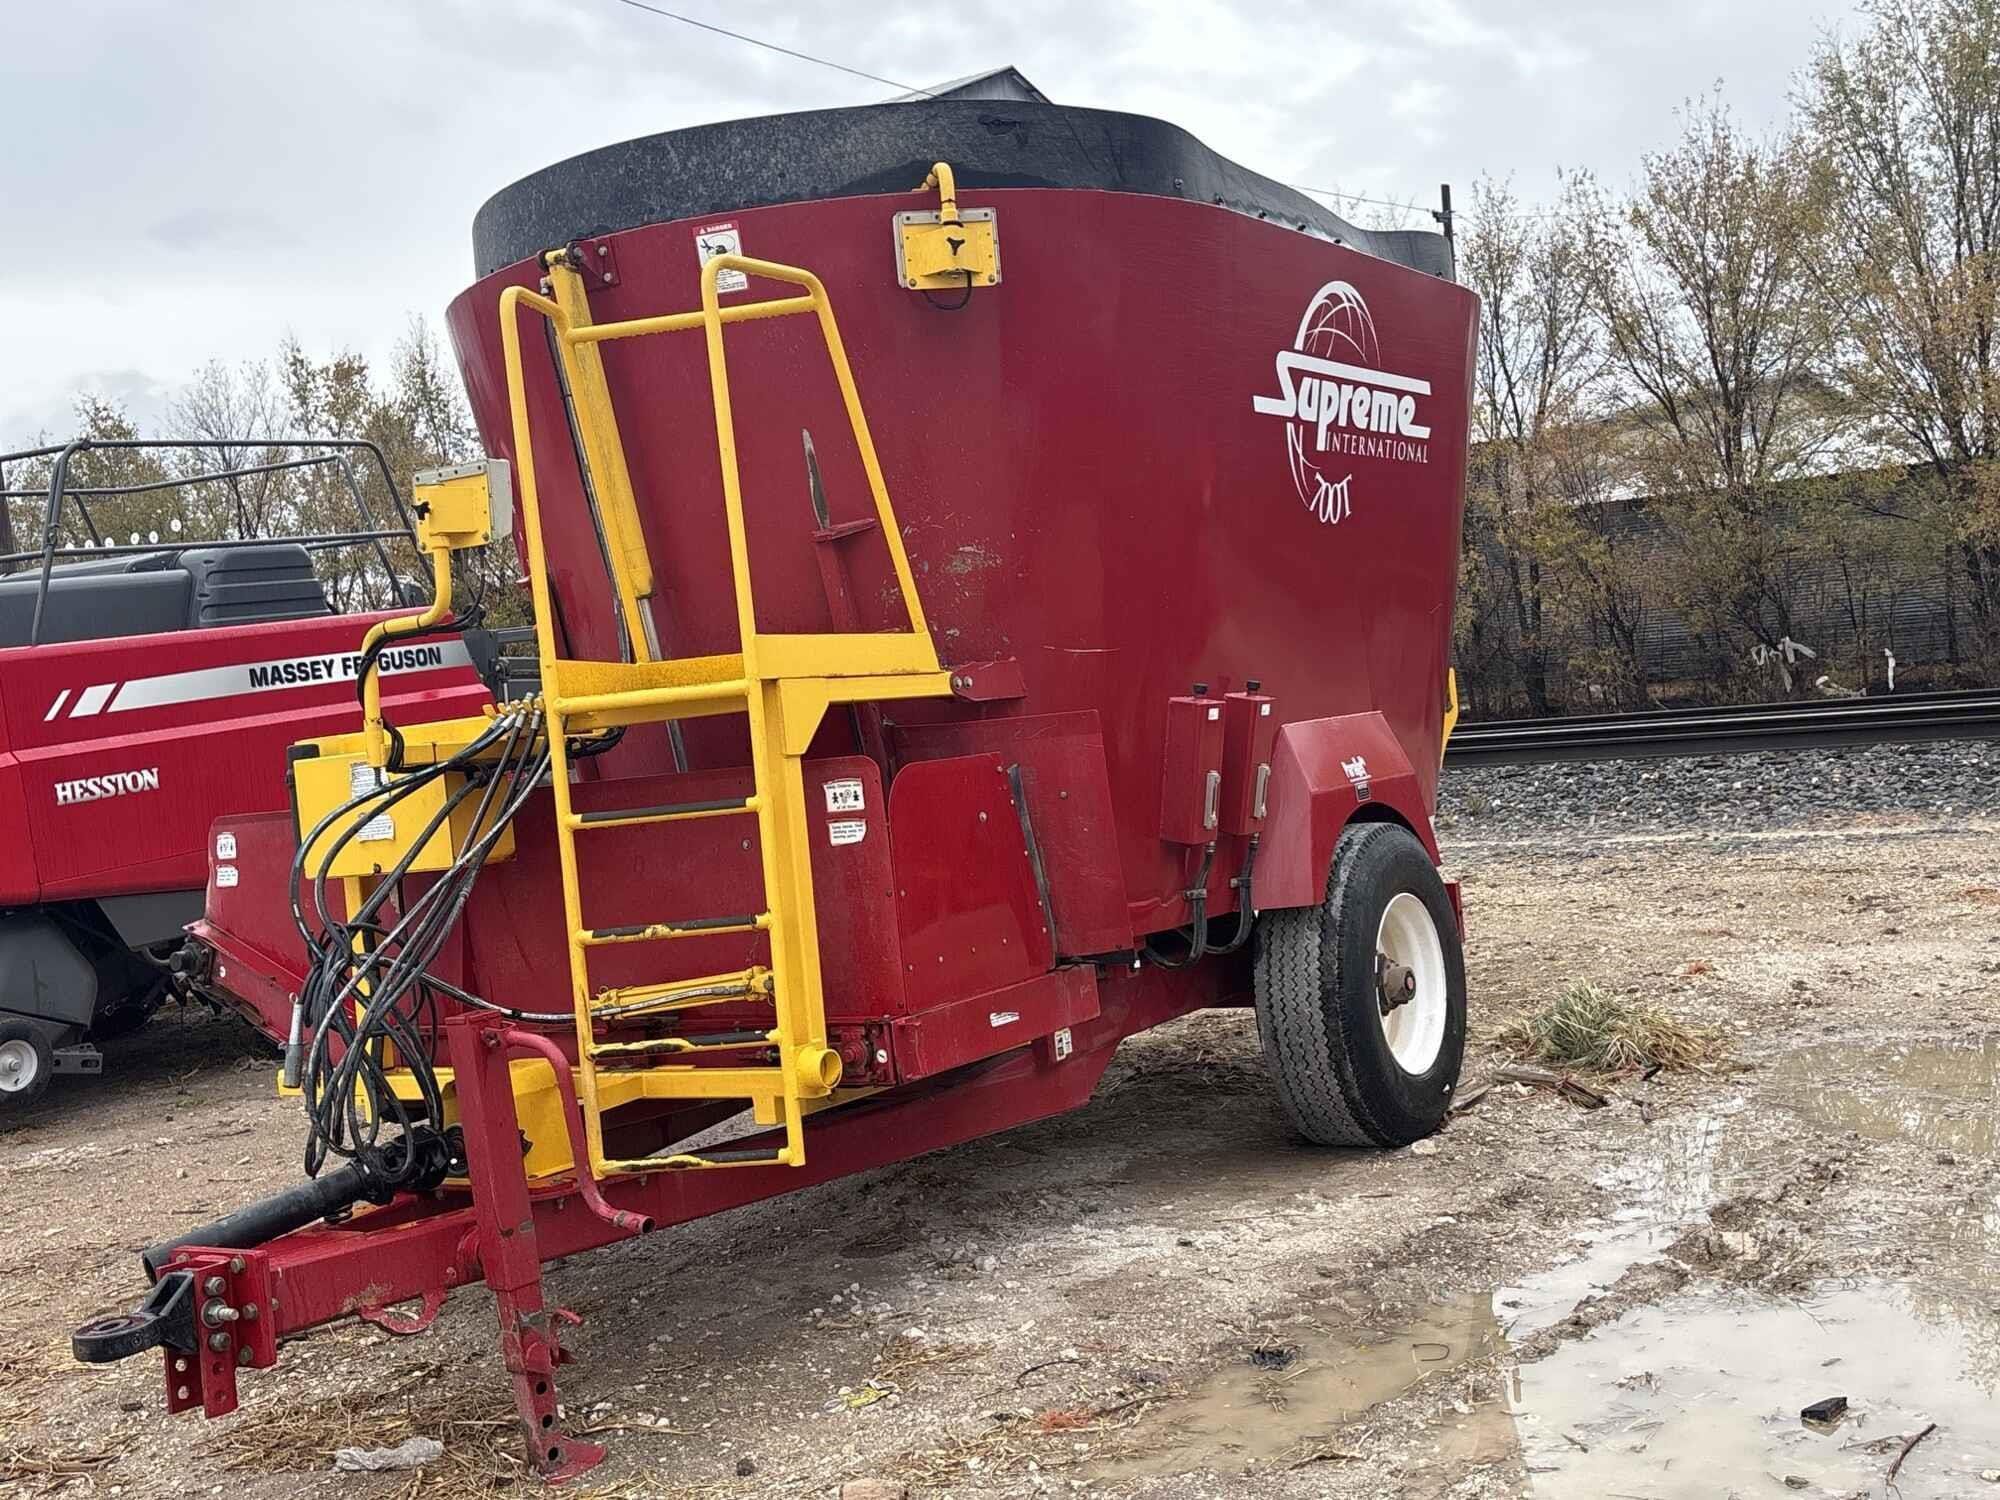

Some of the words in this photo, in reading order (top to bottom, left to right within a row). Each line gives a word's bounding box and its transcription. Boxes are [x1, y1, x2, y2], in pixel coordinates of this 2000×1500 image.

[1253, 350, 1432, 451] Supreme
[1326, 431, 1428, 464] INTERNATIONAL
[248, 657, 335, 688] MASSEY
[341, 646, 442, 677] FEGUSON
[54, 767, 159, 806] HESSTON
